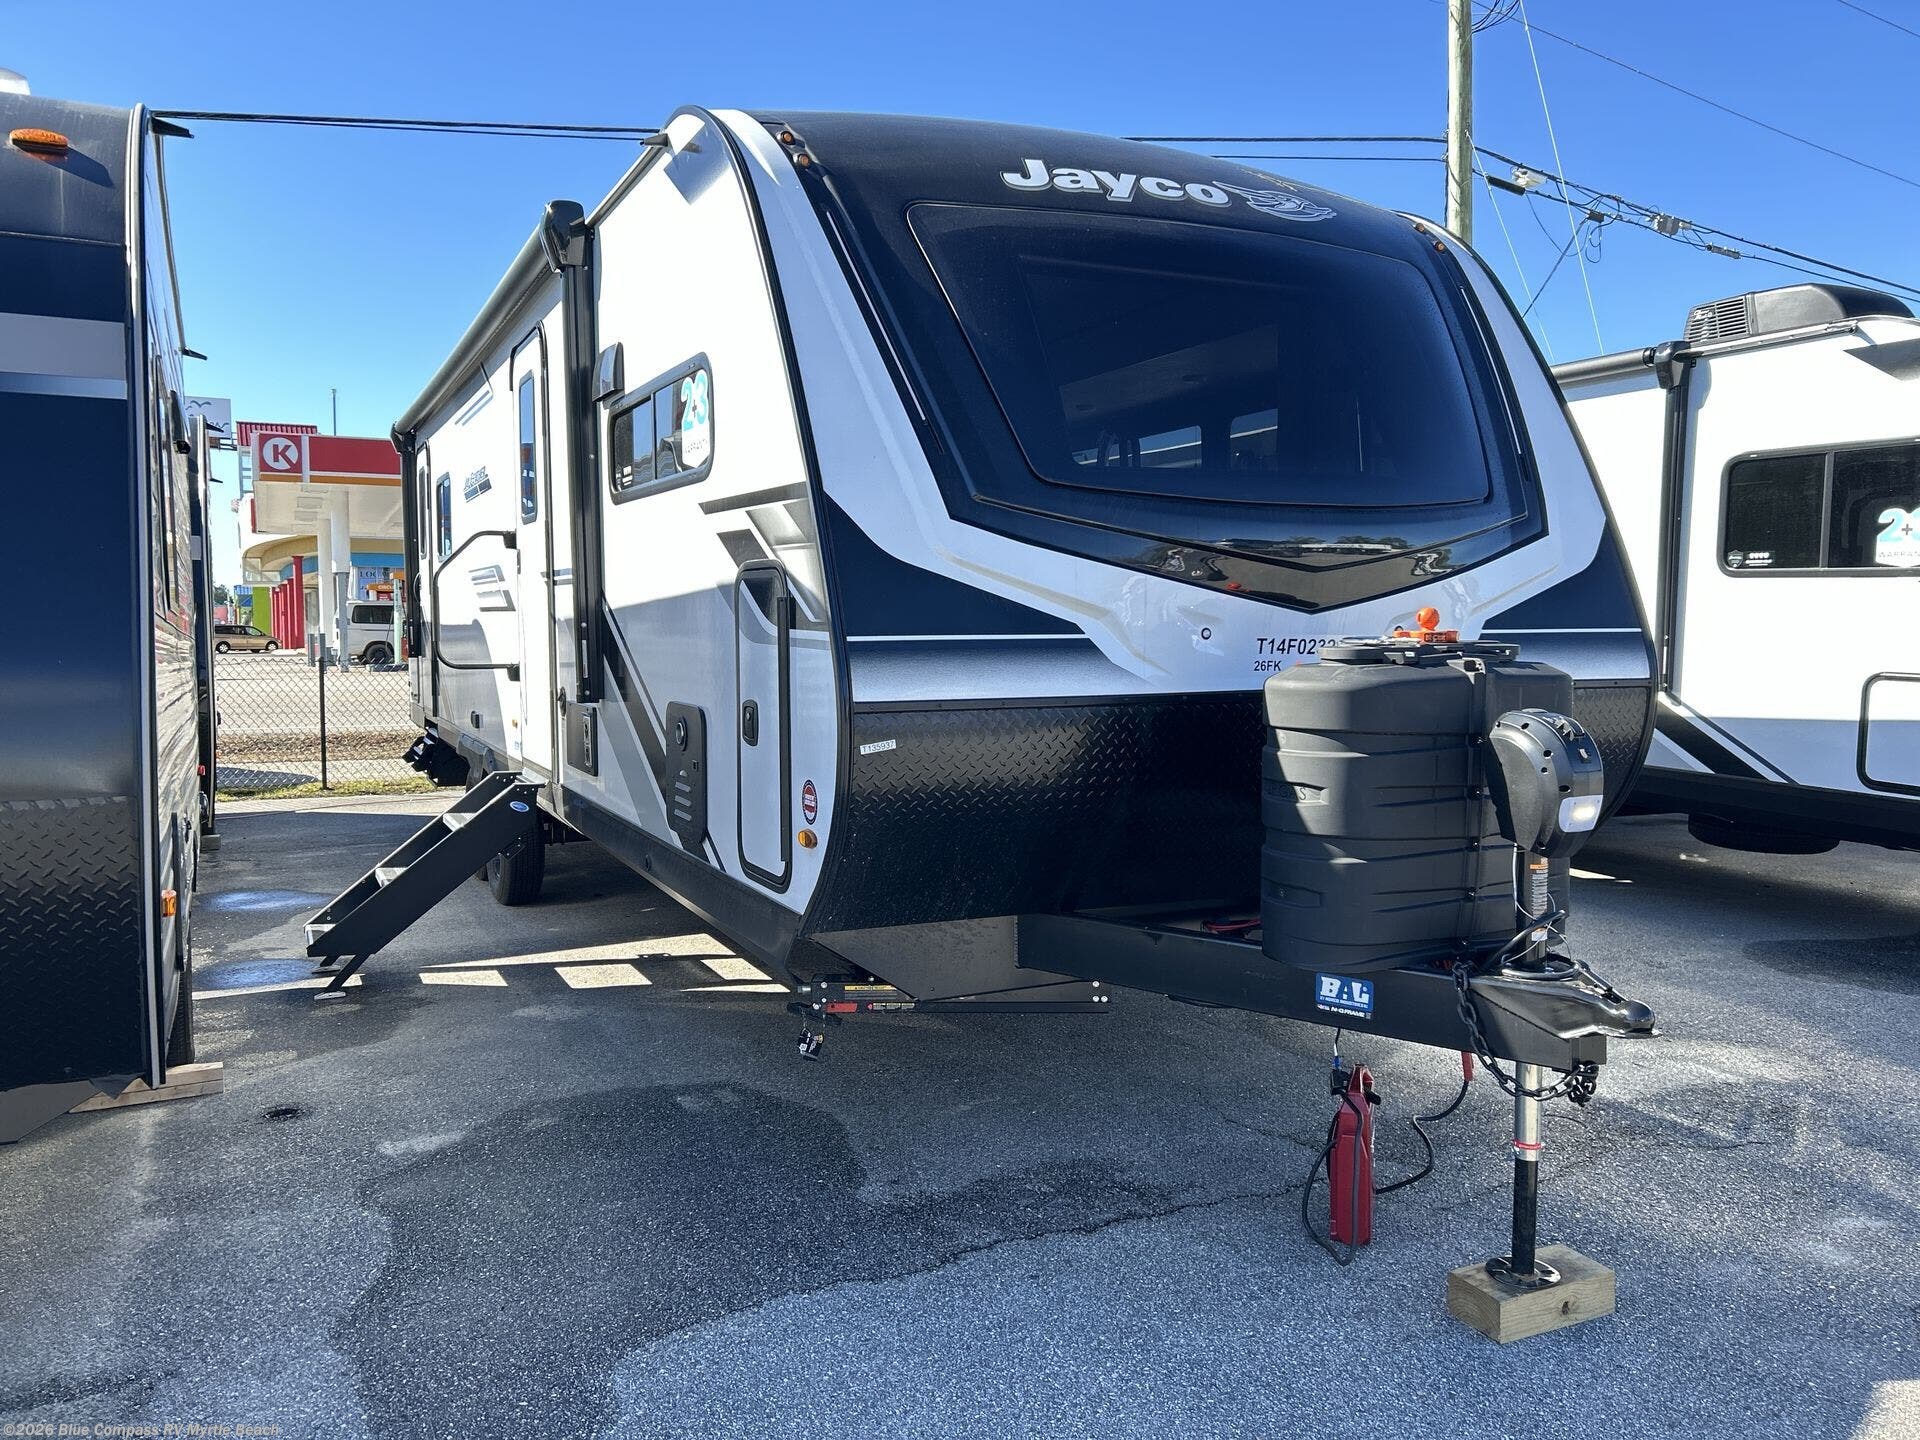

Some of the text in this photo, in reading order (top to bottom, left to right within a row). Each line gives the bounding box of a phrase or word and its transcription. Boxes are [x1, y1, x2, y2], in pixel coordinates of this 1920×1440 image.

[1001, 158, 1232, 207] Jayco
[272, 443, 294, 467] K
[1254, 660, 1281, 672] 26FK
[861, 740, 895, 753] T135937
[1320, 976, 1369, 1004] BAL
